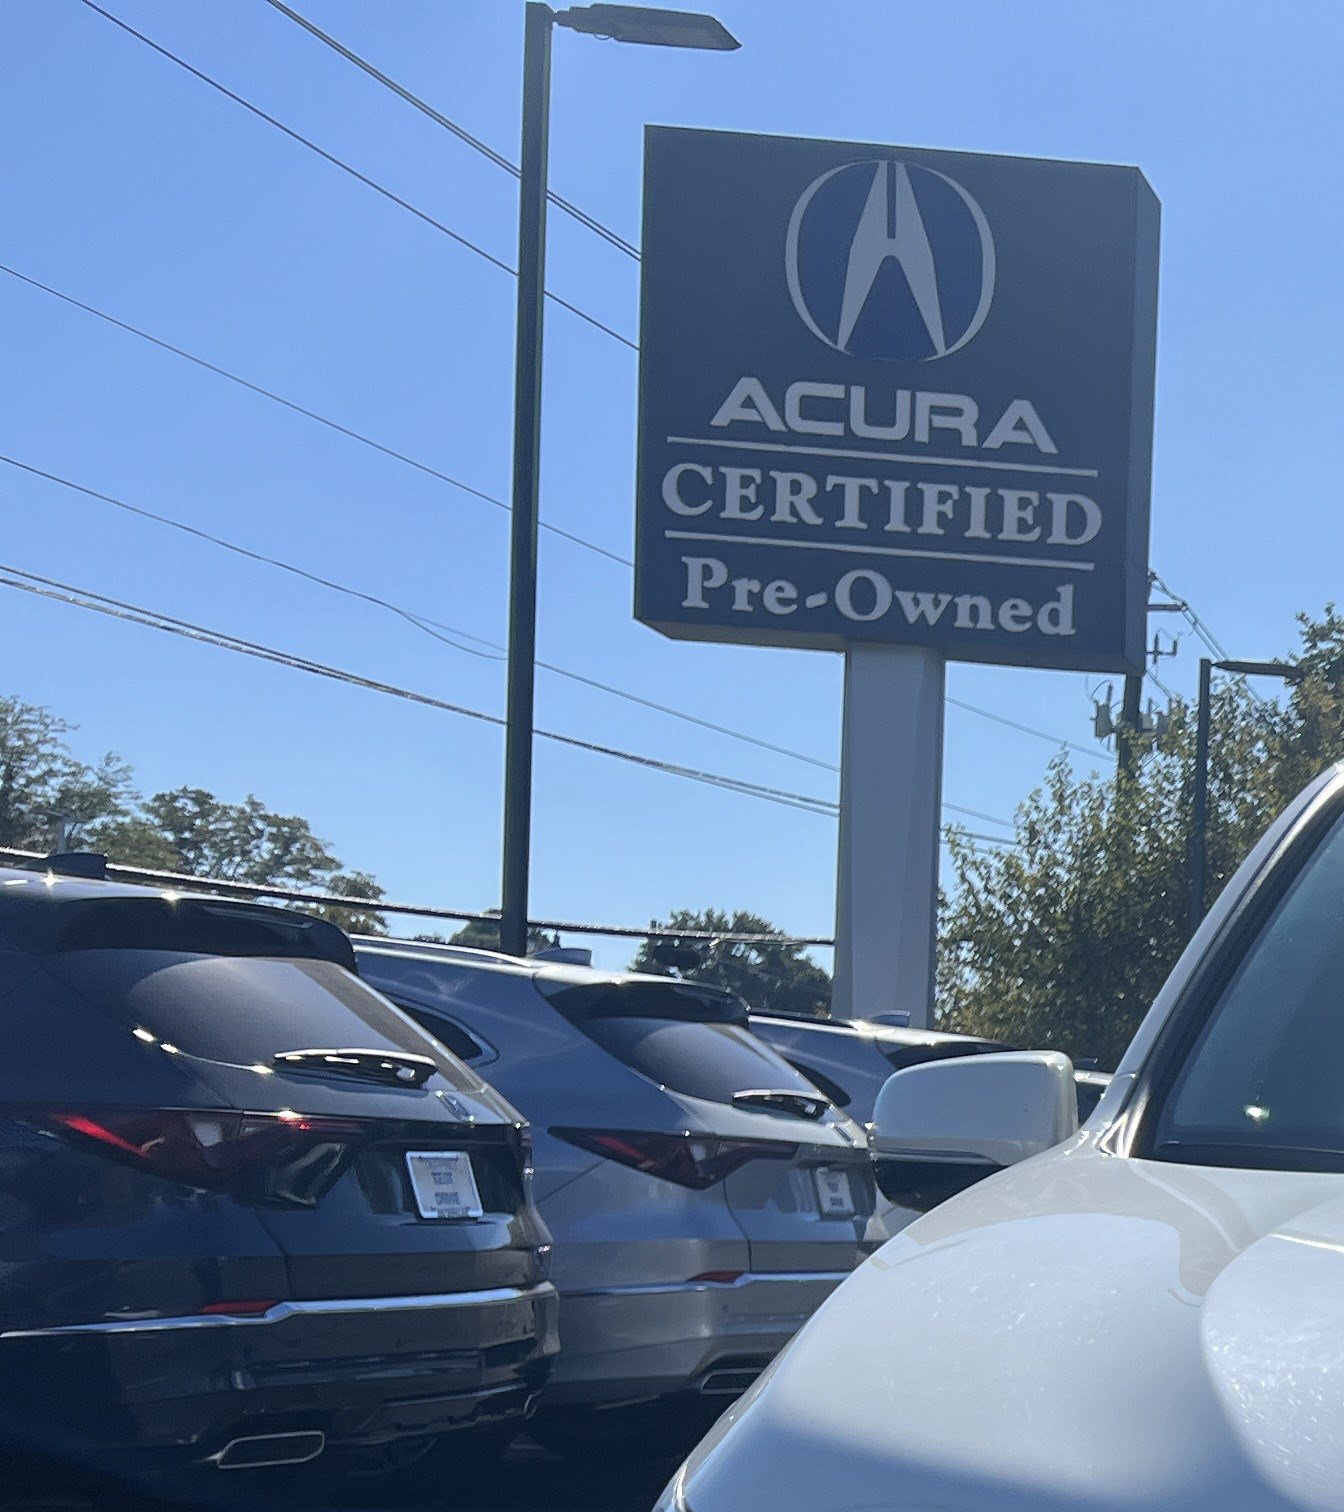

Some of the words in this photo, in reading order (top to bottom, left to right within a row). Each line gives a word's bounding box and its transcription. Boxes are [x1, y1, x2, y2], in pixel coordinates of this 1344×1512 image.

[710, 376, 1059, 454] ACURA
[661, 462, 1103, 547] CERTIFIED
[681, 556, 1077, 636] Pre-Owned
